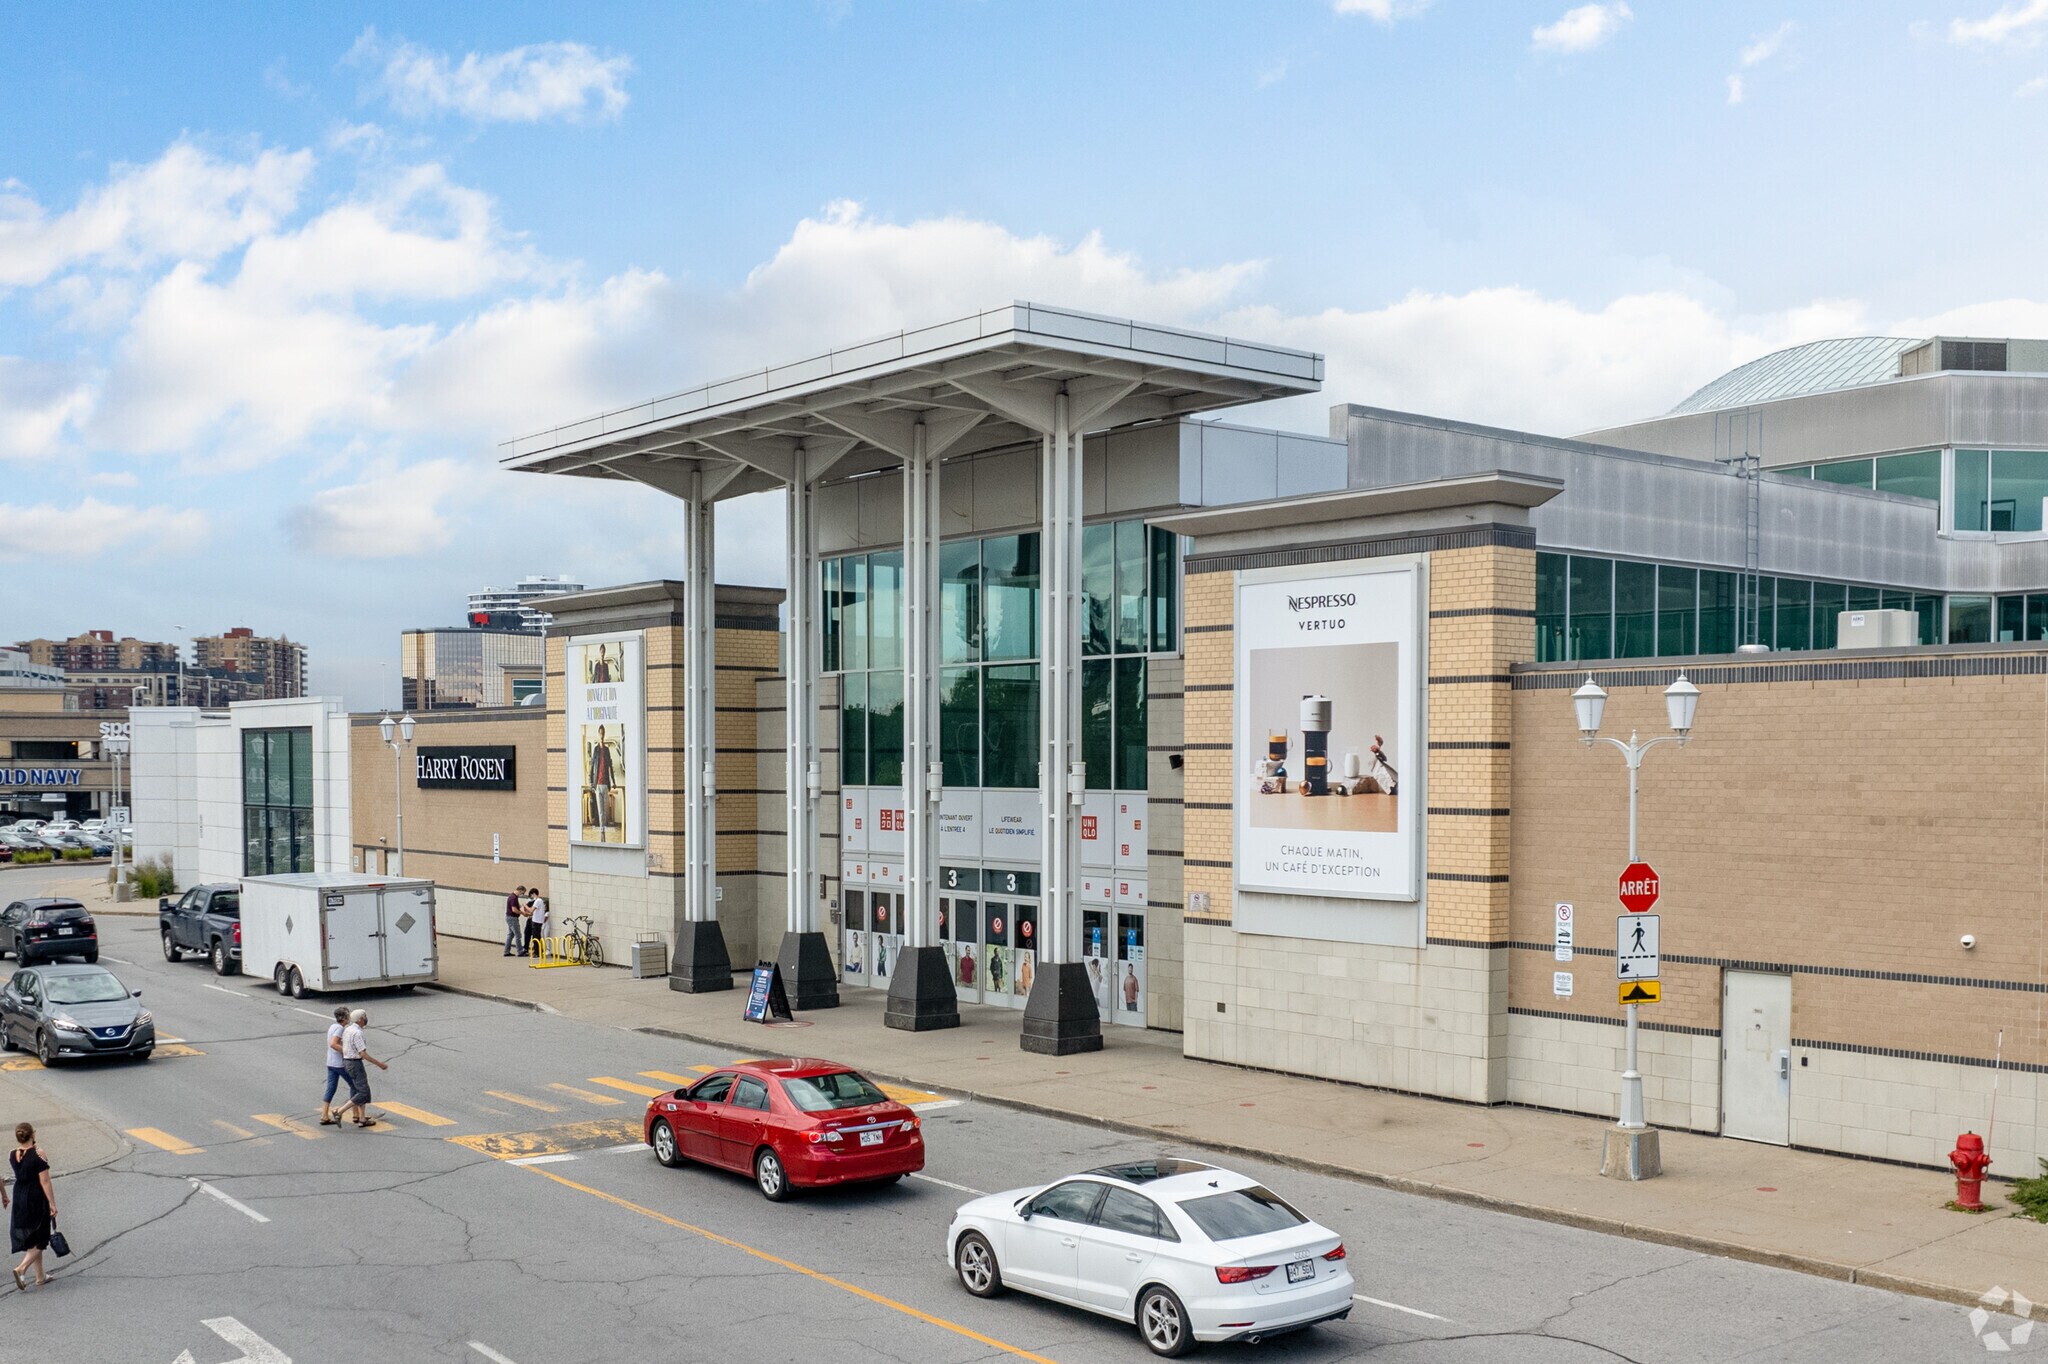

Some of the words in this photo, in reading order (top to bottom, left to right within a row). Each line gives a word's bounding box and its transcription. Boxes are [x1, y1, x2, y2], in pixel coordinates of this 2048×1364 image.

[1286, 593, 1356, 612] NESPRESSO
[1298, 618, 1346, 631] VERTUO
[416, 755, 458, 779] HARRY
[460, 755, 506, 780] ROSEN
[30, 769, 82, 786] NAVY
[115, 812, 126, 823] 15
[958, 814, 973, 822] OUVERT
[1281, 845, 1323, 857] CHAQUE
[1326, 847, 1363, 860] MATIN,
[1265, 861, 1279, 872] UN
[1282, 860, 1308, 874] CAFÉ
[1311, 863, 1381, 877] D'EXCEPTION
[948, 869, 957, 887] 3
[1006, 873, 1016, 892] 3
[1620, 877, 1658, 896] ARRÊT
